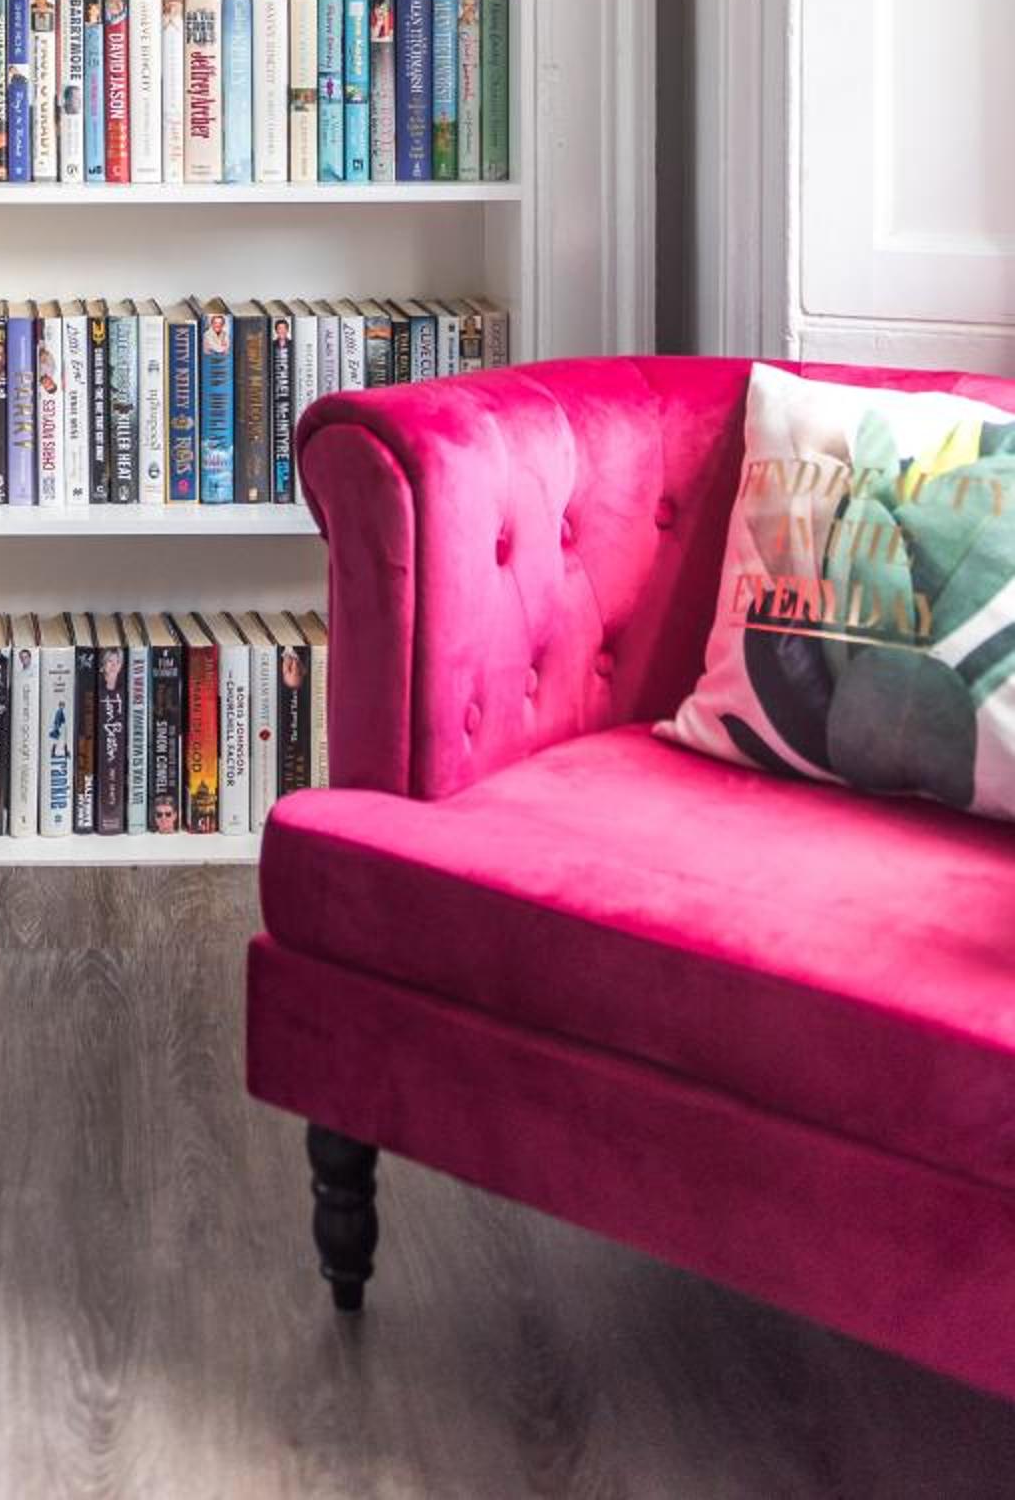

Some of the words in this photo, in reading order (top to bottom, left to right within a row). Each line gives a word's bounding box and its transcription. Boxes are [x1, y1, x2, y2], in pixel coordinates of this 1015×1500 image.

[70, 0, 81, 81] BARRYMORE
[110, 33, 125, 74] DAVID
[186, 51, 217, 97] Jeffrey
[110, 75, 125, 119] JASON
[190, 97, 217, 139] Archer
[174, 327, 190, 363] KITTY
[420, 324, 433, 358] CLIVE
[274, 346, 290, 398] MICHAEL
[42, 399, 56, 439] MOYLES
[117, 413, 132, 450] KILLER
[42, 440, 56, 471] CHRIS
[117, 453, 132, 481] HEAT
[741, 460, 822, 500] FIND
[823, 463, 1005, 518] BEAUTY
[776, 515, 811, 553] IN
[829, 518, 911, 568] THE
[225, 681, 234, 742] CHURCHILL
[237, 686, 245, 719] BORIS
[155, 720, 168, 752] SIMON
[236, 720, 245, 776] JOHNSON
[155, 755, 168, 795] COWELL
[225, 744, 234, 788] FACTOR
